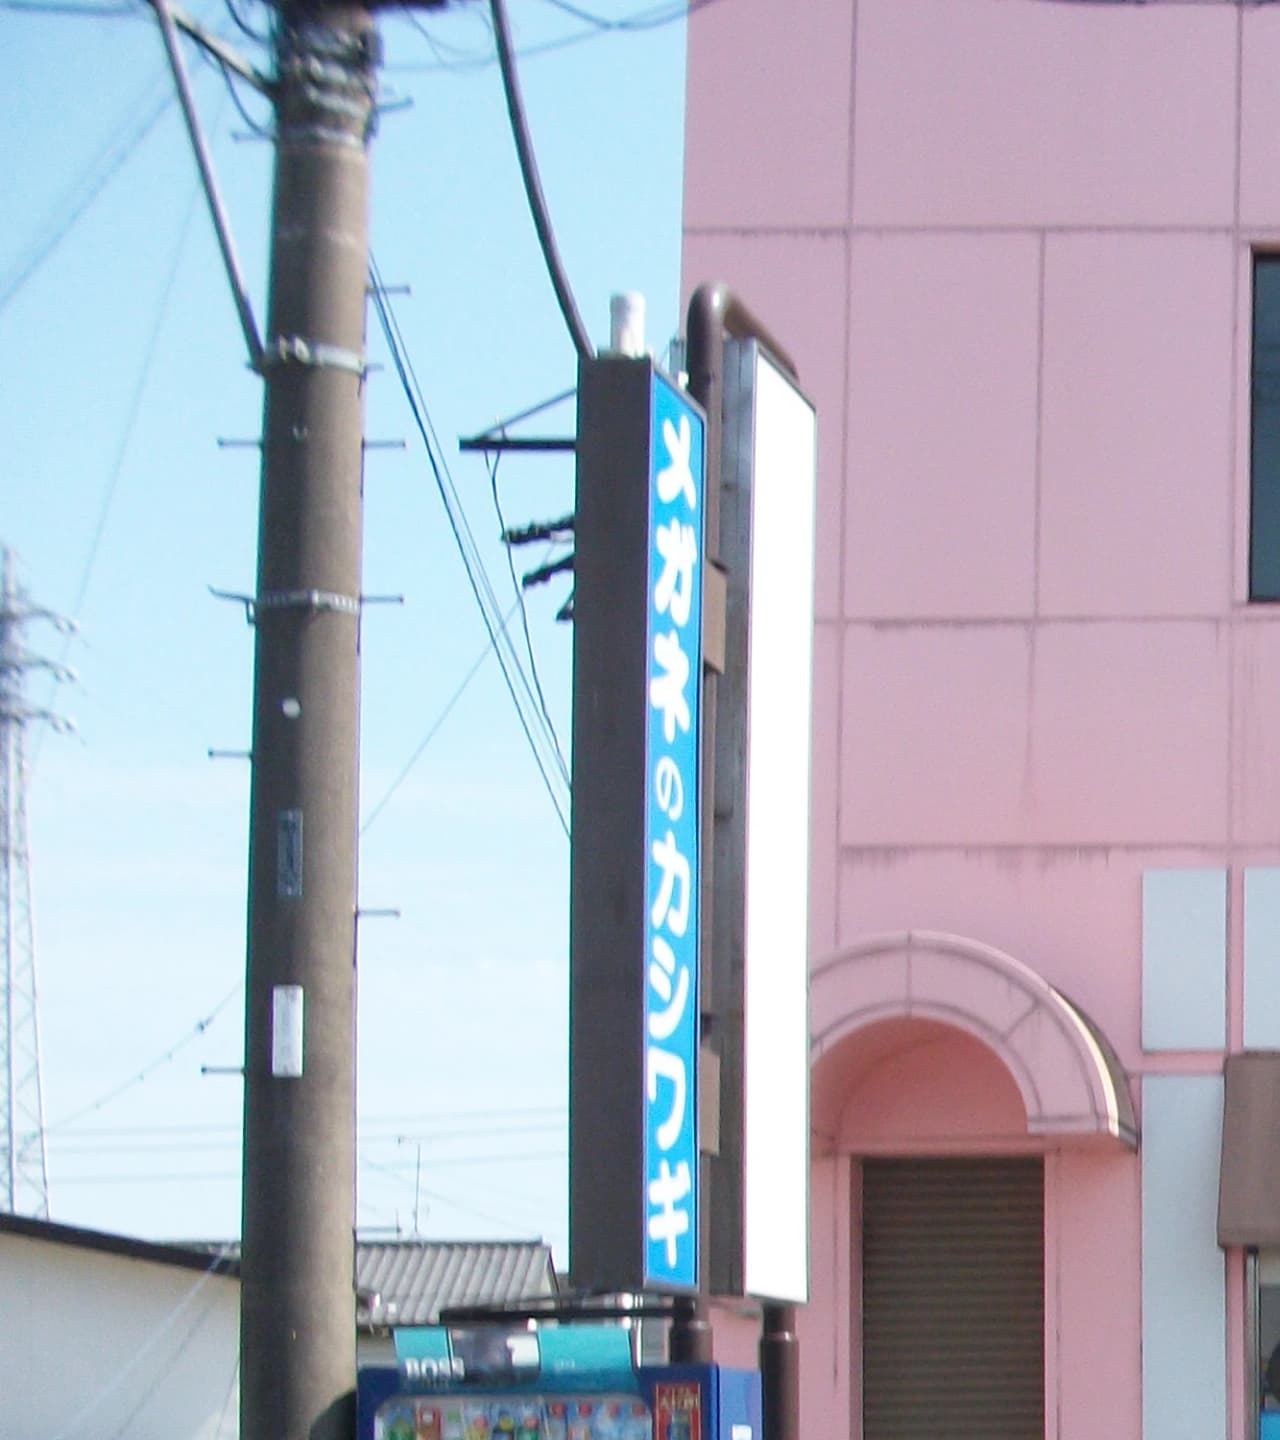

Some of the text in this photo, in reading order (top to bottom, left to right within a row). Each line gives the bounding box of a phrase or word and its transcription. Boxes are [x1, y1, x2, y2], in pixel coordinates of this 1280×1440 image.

[649, 412, 699, 1271] メガネのカシワギ
